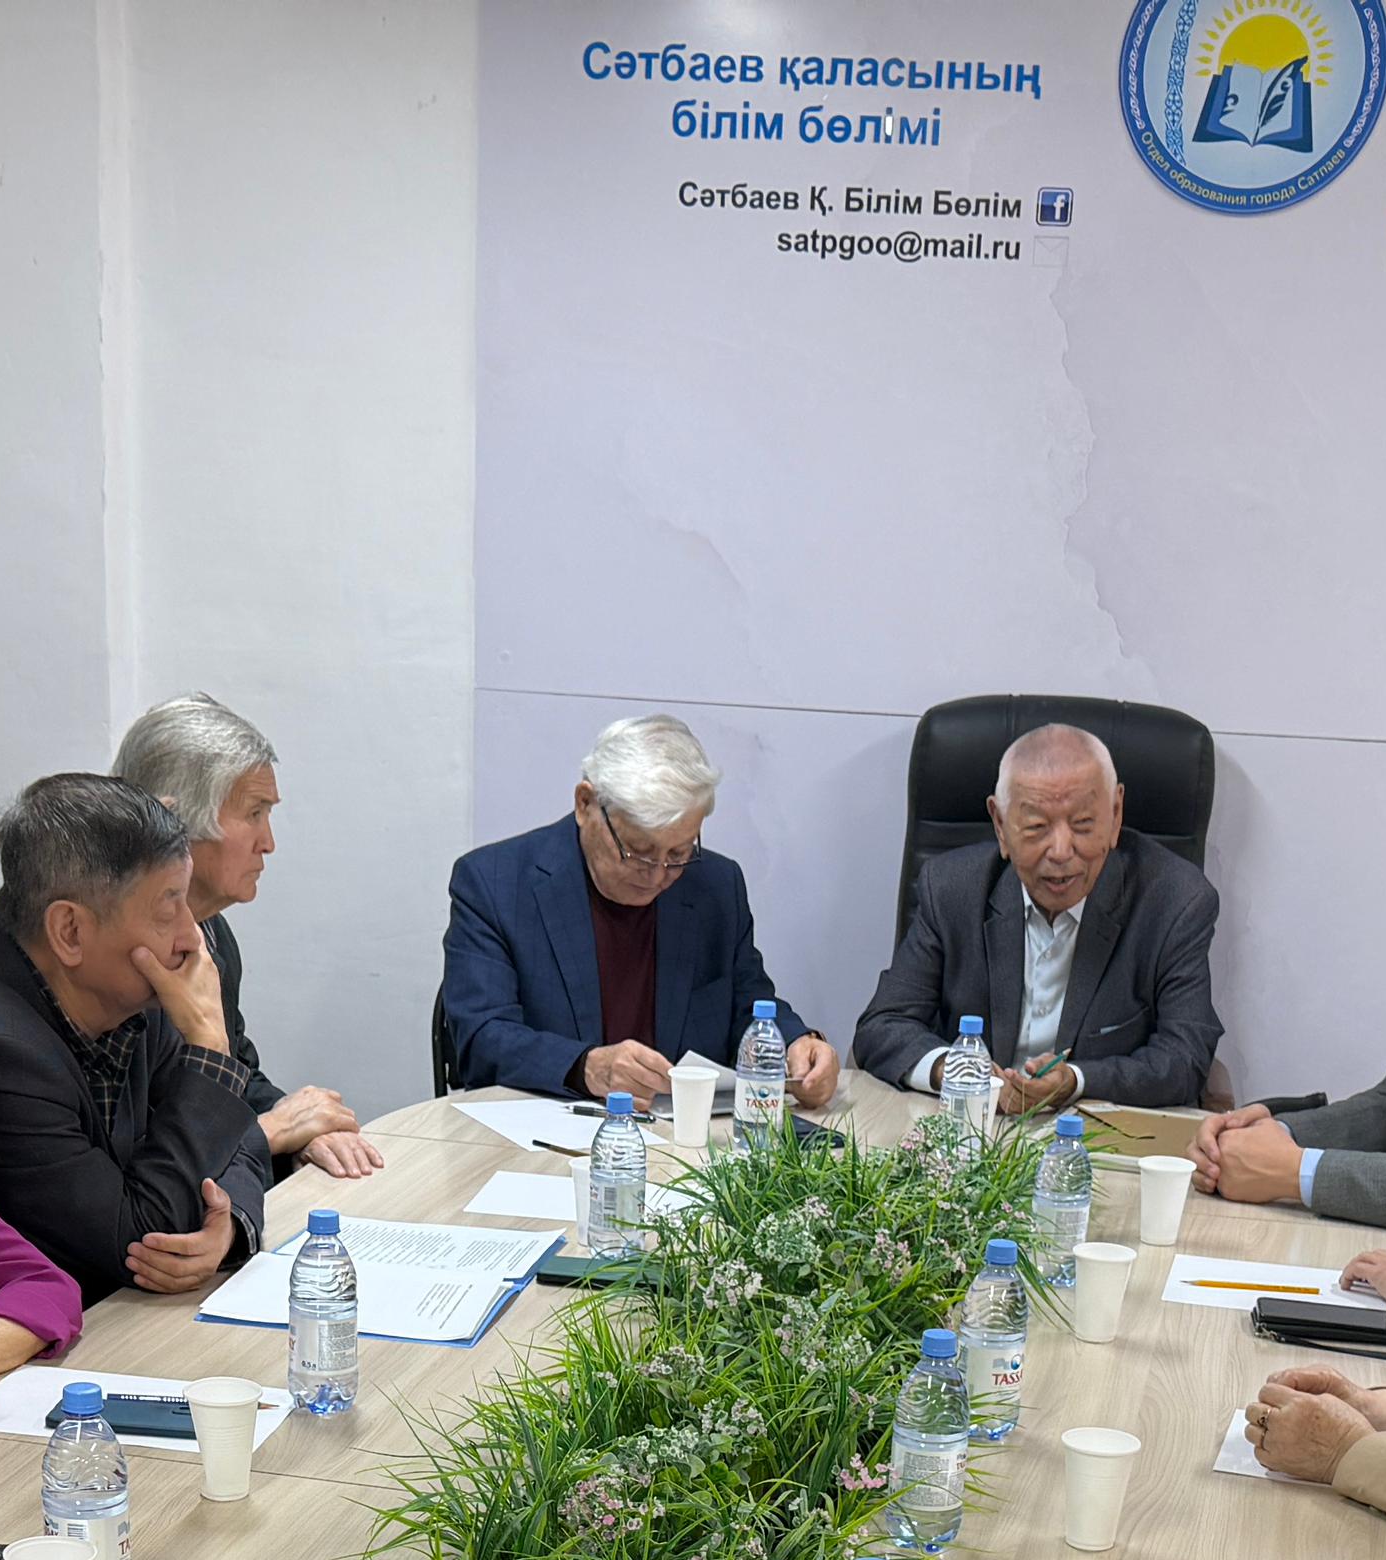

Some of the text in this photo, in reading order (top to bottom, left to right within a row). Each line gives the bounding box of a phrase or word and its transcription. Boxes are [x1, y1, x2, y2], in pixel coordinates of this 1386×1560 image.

[581, 41, 1042, 99] Сәтбаев қаласының
[671, 100, 941, 146] білім бөлімі
[1141, 131, 1347, 206] Отдел образования города Сатпаев
[678, 181, 1022, 219] Сәтбаев Қ. Білім Бөлім
[776, 228, 1021, 263] satpgoo@mail.ru
